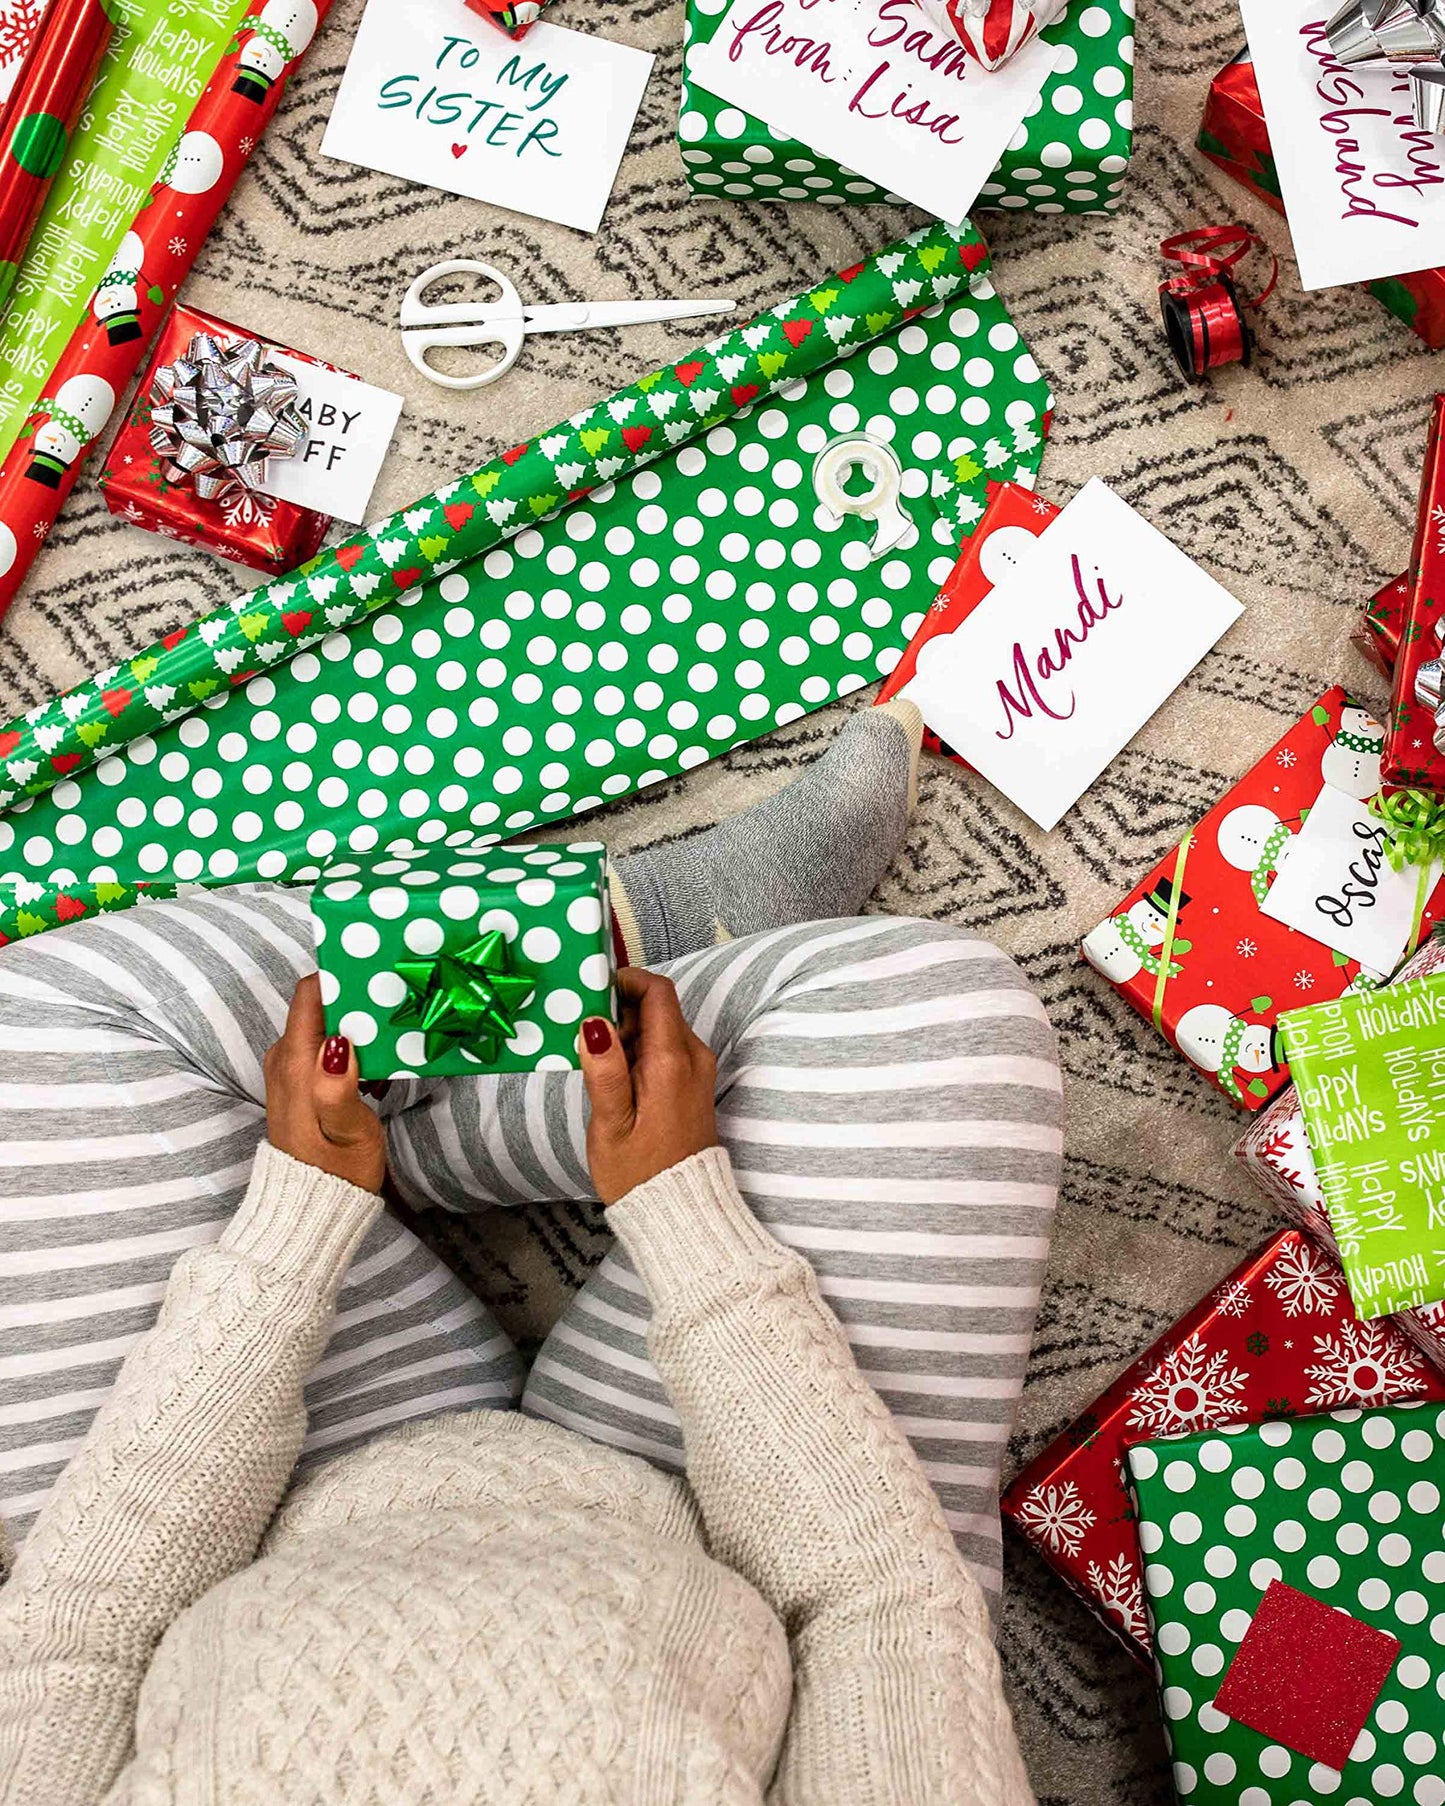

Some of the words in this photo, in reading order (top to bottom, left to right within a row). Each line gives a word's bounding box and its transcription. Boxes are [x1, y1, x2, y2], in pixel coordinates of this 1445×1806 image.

[867, 0, 966, 81] Sam
[377, 75, 562, 157] SISTER
[848, 61, 964, 144] Lisa
[299, 398, 361, 434] ABY
[995, 554, 1123, 740] Mandi
[1315, 822, 1397, 927] Oscar
